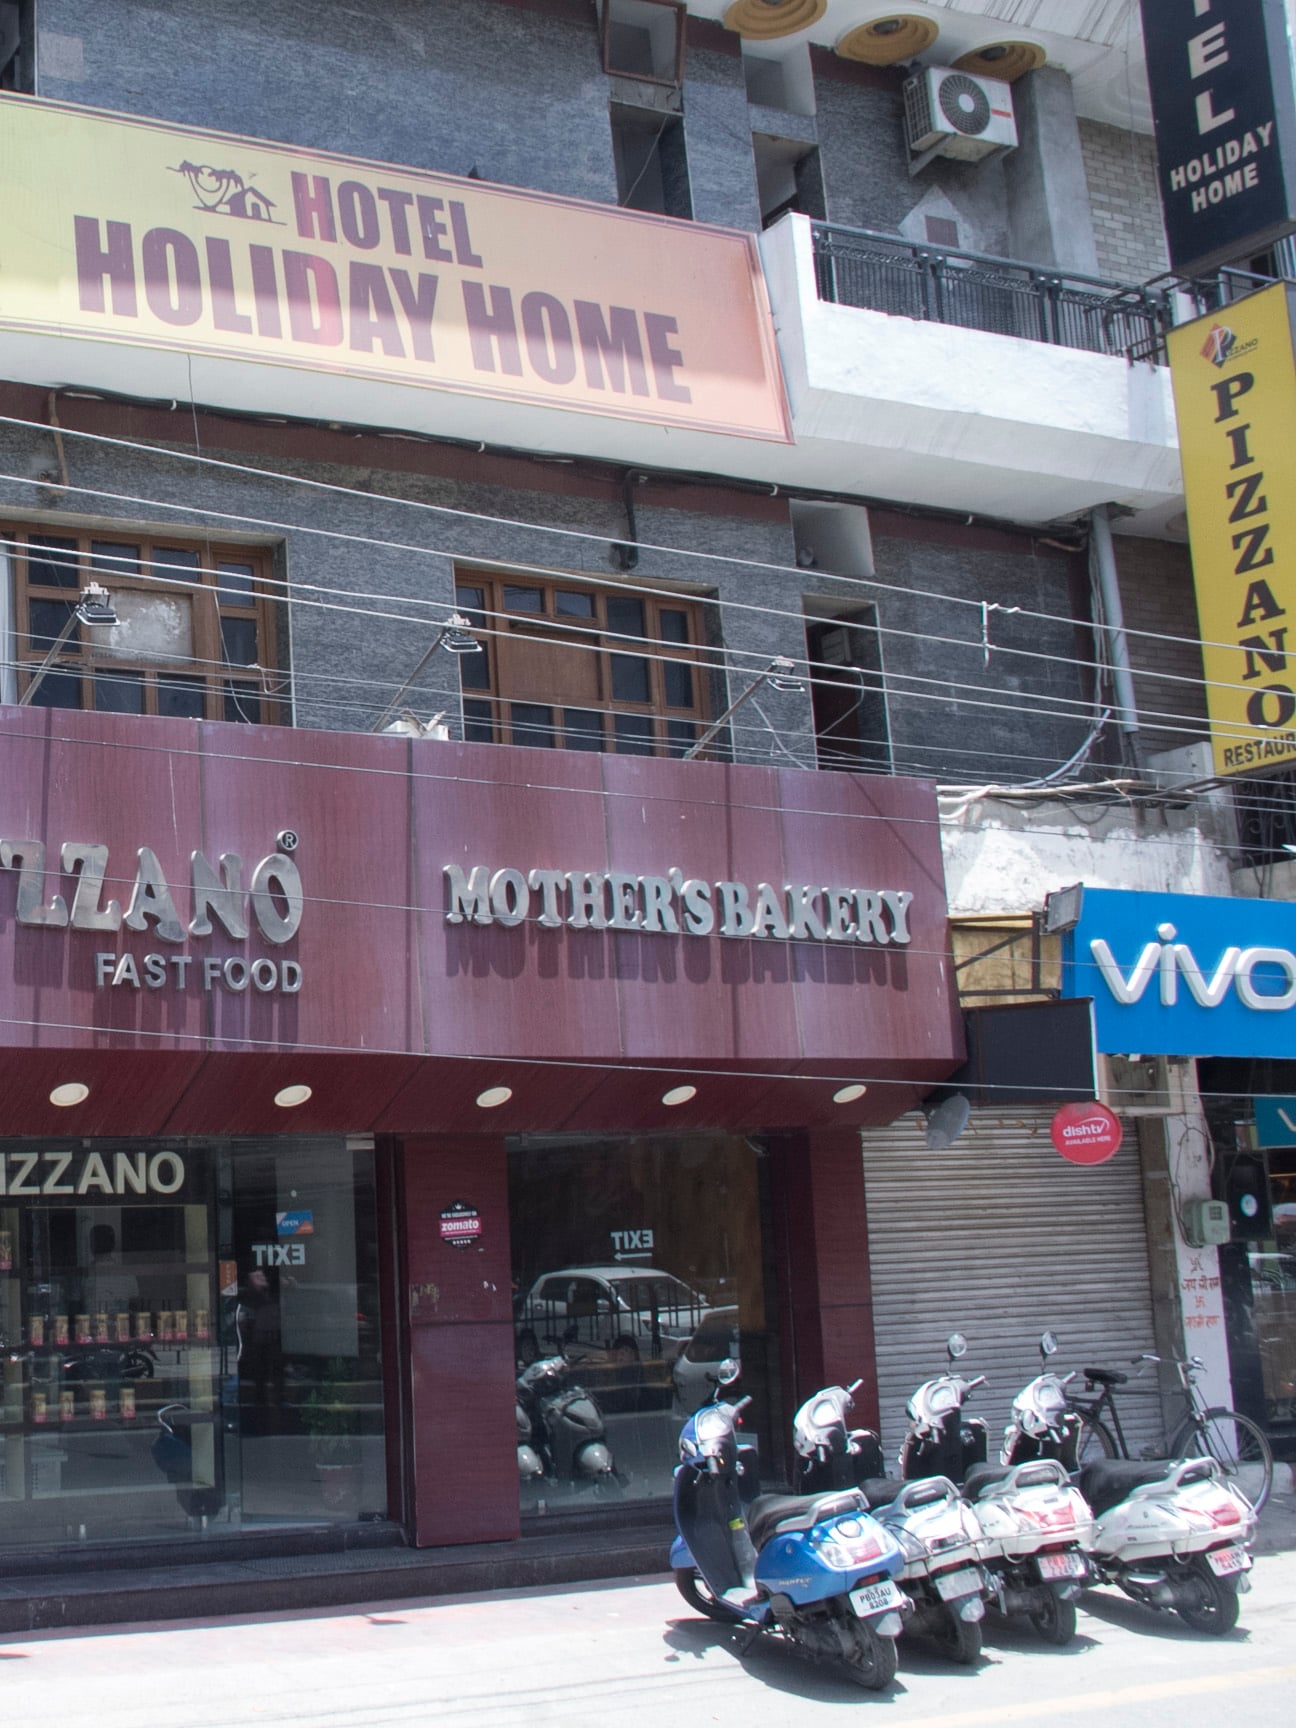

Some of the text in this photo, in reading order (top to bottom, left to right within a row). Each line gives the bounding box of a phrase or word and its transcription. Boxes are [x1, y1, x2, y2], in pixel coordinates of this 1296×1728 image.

[1187, 0, 1236, 135] EL
[1170, 121, 1273, 192] HOLIDAY
[1191, 162, 1260, 214] HOME
[290, 171, 484, 269] HOTEL
[73, 215, 691, 404] HOLIDAY HOME
[1210, 371, 1296, 729] PIZZANO
[442, 864, 915, 944] MOTHER'S BAKERY
[95, 952, 302, 993] FAST FOOD
[1090, 922, 1296, 1011] vivo
[440, 1219, 480, 1232] zomato
